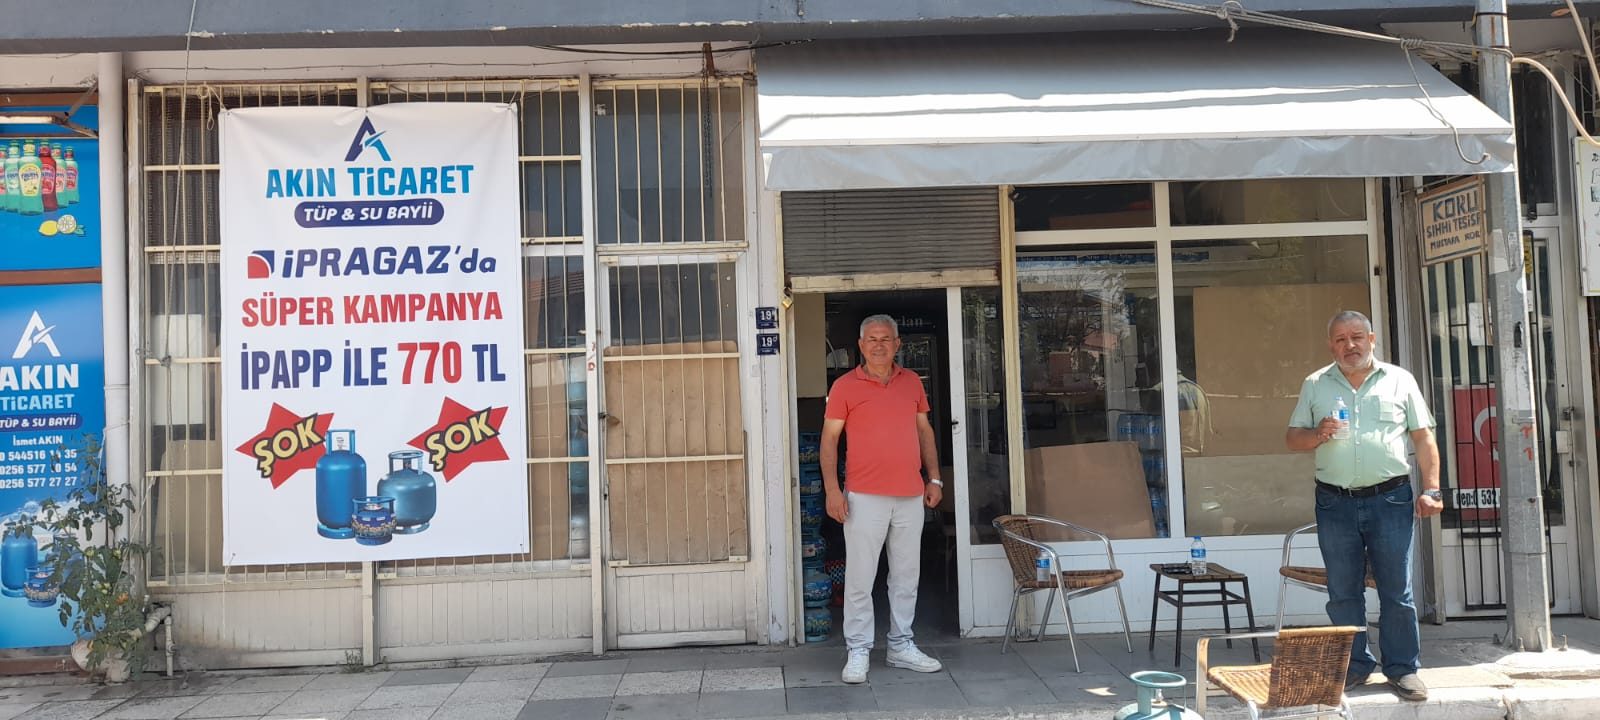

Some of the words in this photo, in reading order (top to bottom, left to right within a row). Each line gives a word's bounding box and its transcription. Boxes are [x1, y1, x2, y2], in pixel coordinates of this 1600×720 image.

[266, 167, 336, 198] AKIN
[304, 205, 337, 222] TÜP
[341, 210, 356, 221] &
[359, 209, 383, 220] SU
[241, 291, 334, 327] SÜPER
[344, 291, 503, 324] KAMPANYA
[240, 343, 332, 390] İPAPP
[343, 340, 387, 386] İLE
[397, 341, 462, 384] 770
[472, 343, 506, 382] TL
[0, 364, 79, 391] AKIN
[0, 417, 19, 428] TÜP
[21, 418, 30, 428] &
[32, 417, 46, 427] SU
[38, 435, 63, 445] AKIN
[253, 413, 326, 478] ŞOK
[425, 407, 500, 472] ŞOK
[8, 449, 46, 461] 544516
[64, 448, 77, 459] 35
[0, 464, 24, 475] 0256
[27, 463, 46, 474] 577
[64, 462, 77, 472] 54
[0, 478, 24, 489] 0256
[27, 477, 46, 488] 577
[49, 476, 61, 487] 27
[64, 476, 77, 486] 27
